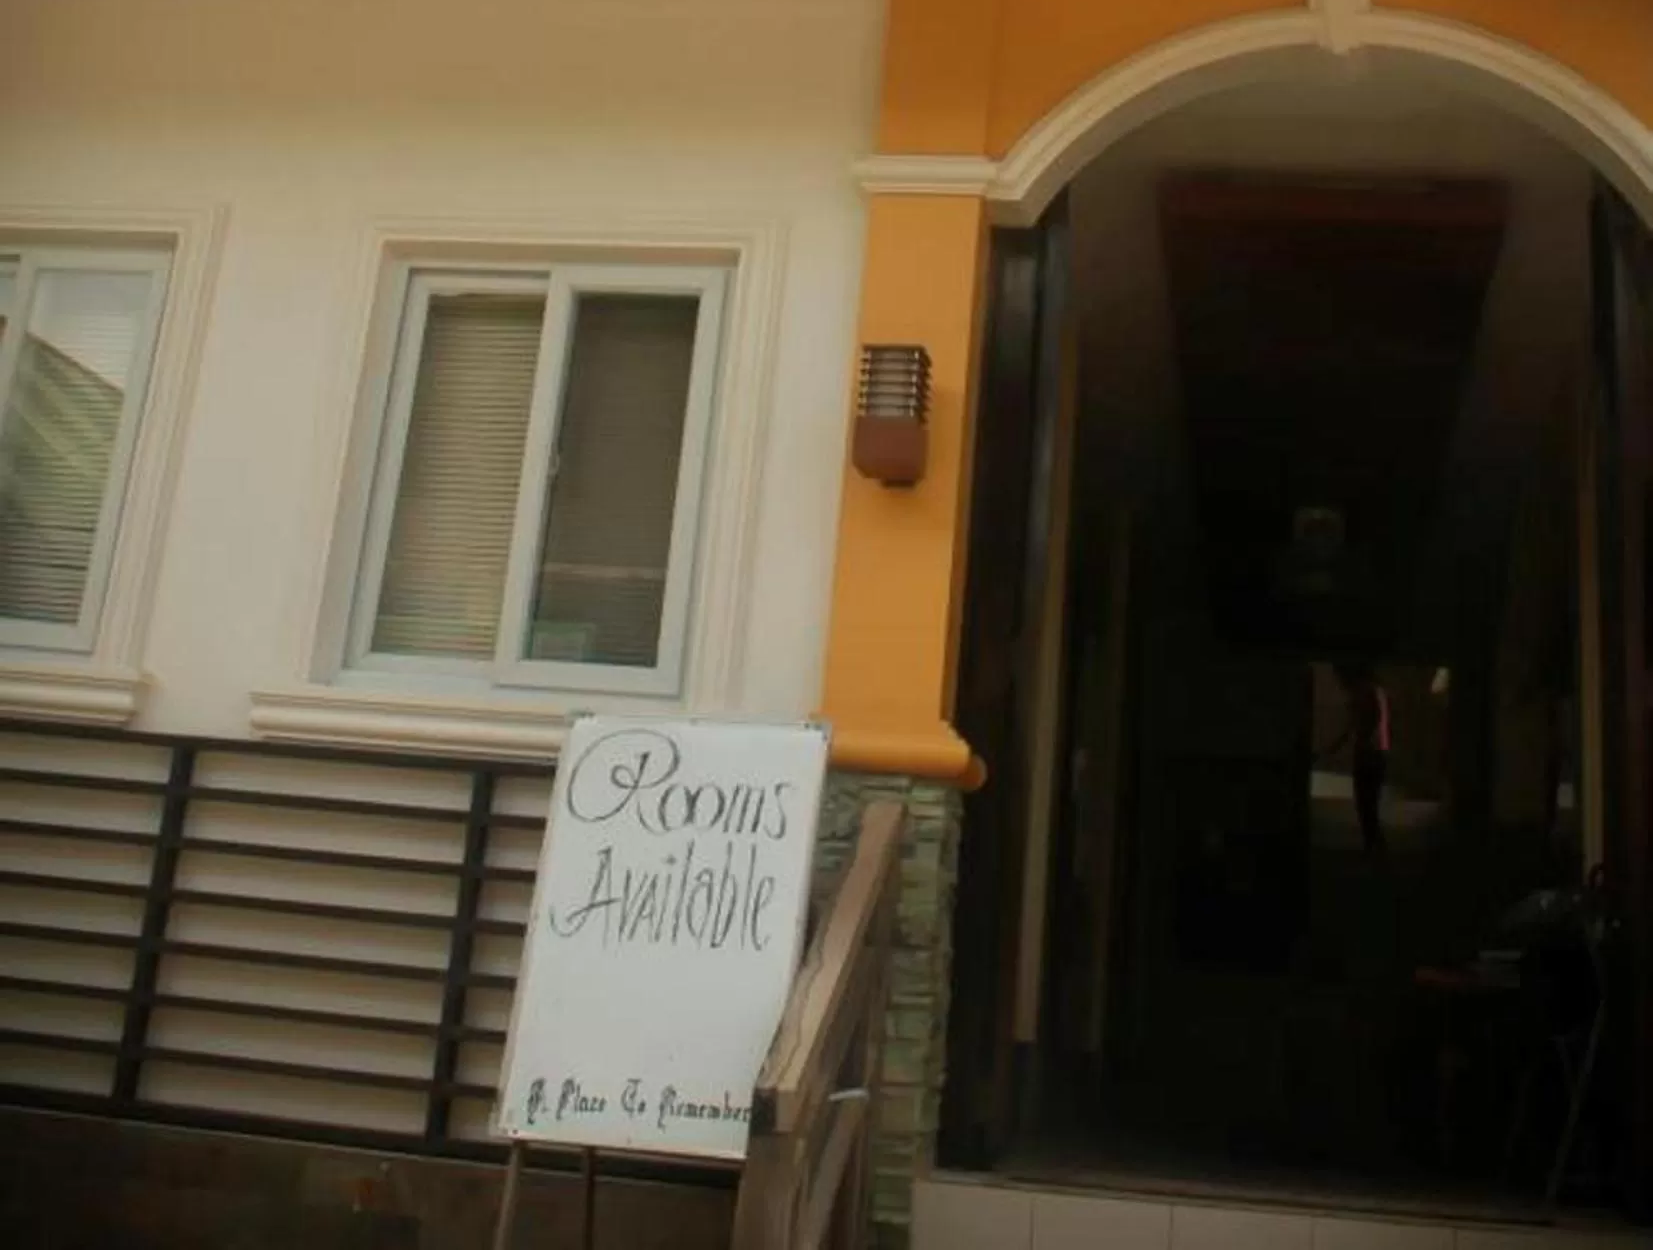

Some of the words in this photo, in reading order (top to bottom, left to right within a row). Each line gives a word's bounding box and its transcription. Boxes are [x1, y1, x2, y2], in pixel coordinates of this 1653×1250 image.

[567, 729, 794, 840] Rooms
[550, 841, 776, 951] Available
[556, 1078, 608, 1121] Place
[657, 1084, 751, 1131] Remember
